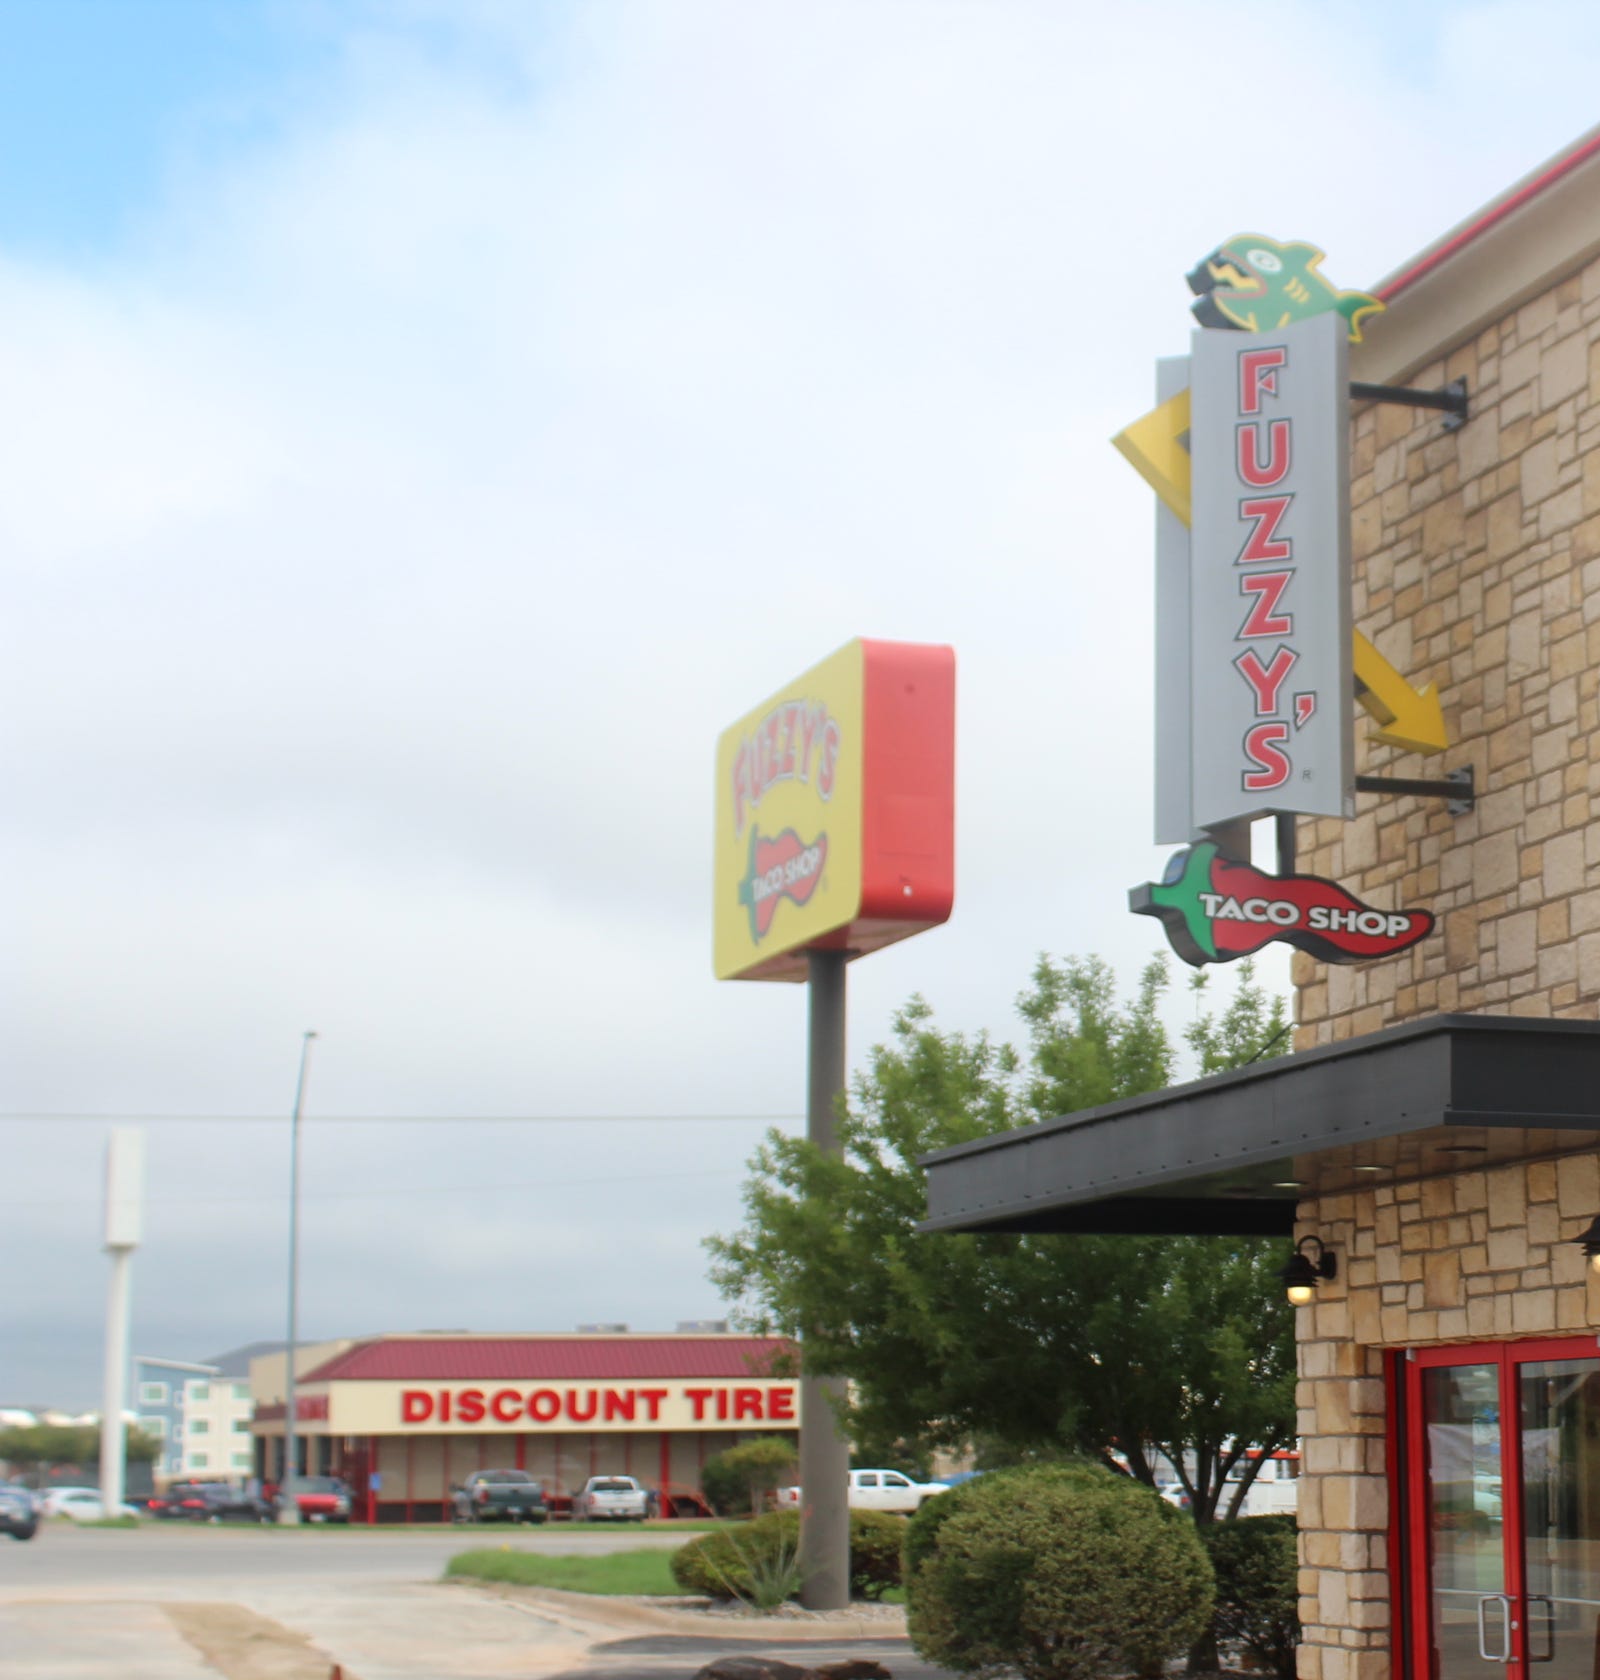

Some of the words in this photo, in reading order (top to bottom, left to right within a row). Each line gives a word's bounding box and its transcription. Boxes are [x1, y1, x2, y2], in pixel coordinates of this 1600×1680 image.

[1232, 344, 1316, 793] FUZZY'S
[731, 697, 839, 842] FUZZY'S
[752, 863, 784, 902] TACO
[784, 846, 821, 886] SHOP
[1198, 892, 1301, 927] TACO
[1306, 905, 1412, 939] SHOP
[399, 1388, 669, 1424] DISCOUNT
[684, 1386, 796, 1421] TIRE
